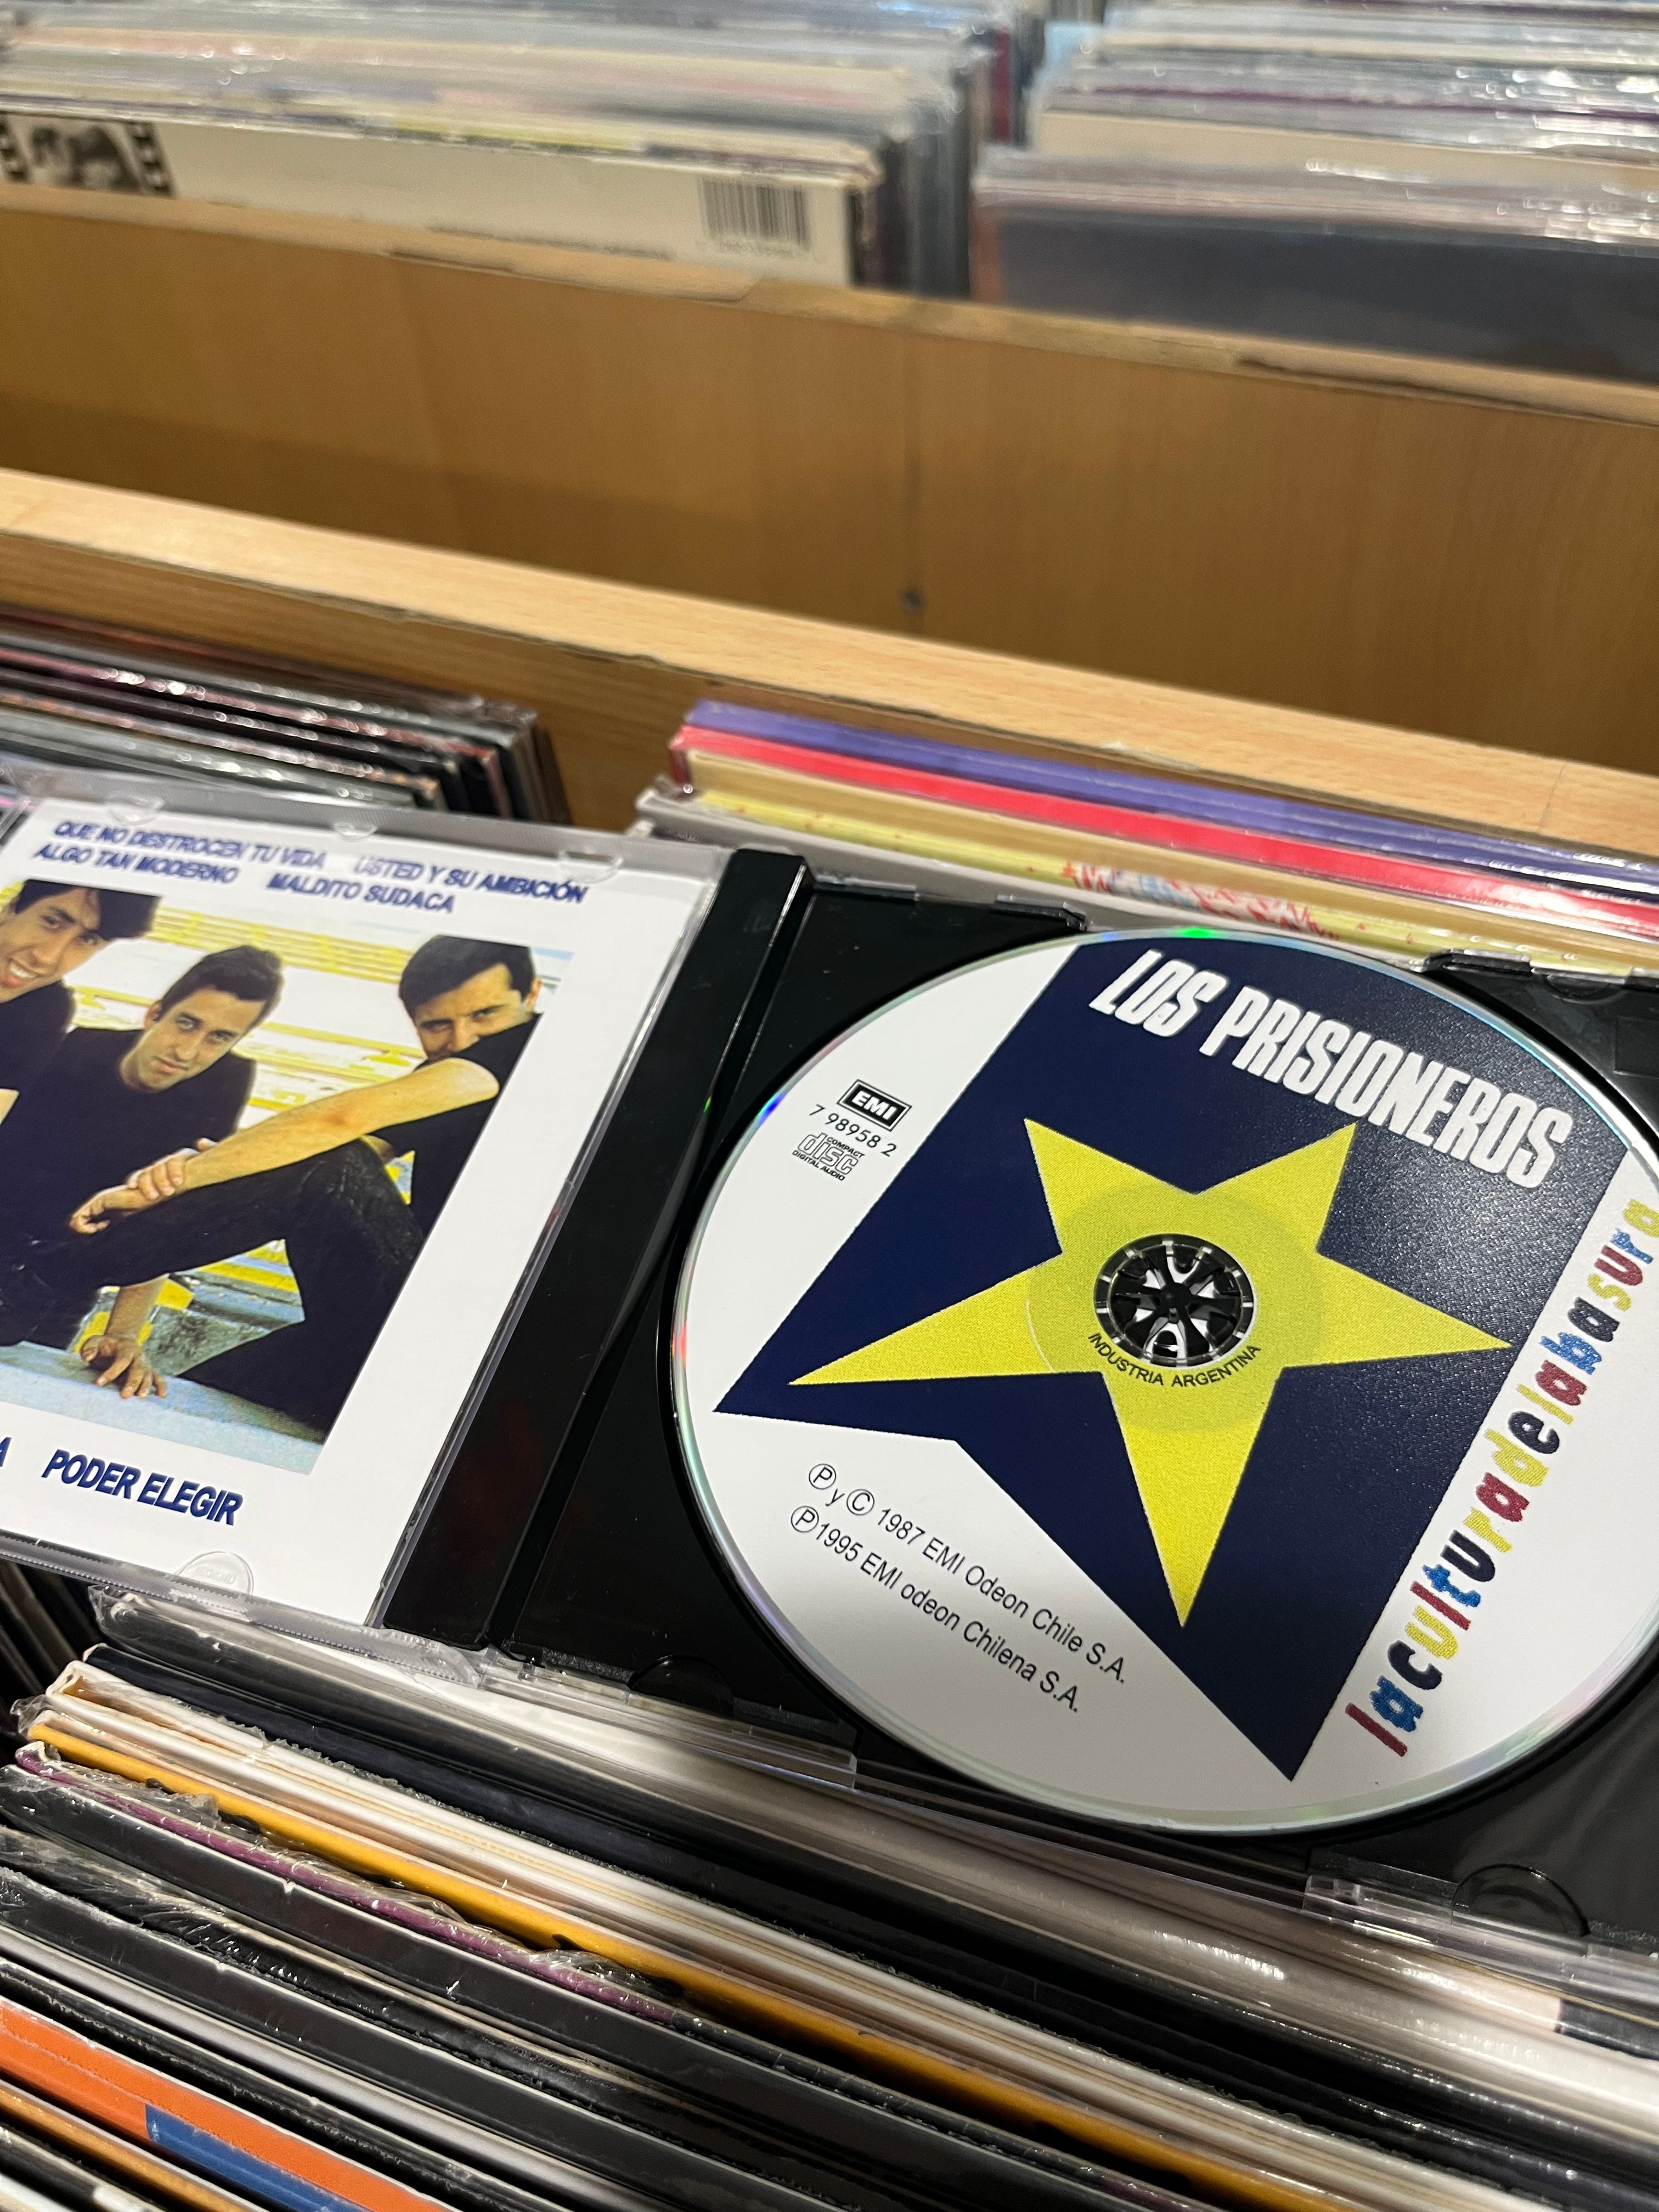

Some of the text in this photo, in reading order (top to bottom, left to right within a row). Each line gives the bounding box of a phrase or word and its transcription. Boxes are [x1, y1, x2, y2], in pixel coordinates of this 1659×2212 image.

[34, 844, 242, 884] ALGO TAN MODERNO
[55, 821, 328, 870] QUE NO DESTROCEN TU VIDA
[267, 872, 457, 913] MALDITO SUDACA
[354, 855, 589, 904] USTED Y SU AMBICIÓN
[1088, 948, 1573, 1188] LOS PRISIONEROS
[851, 1089, 898, 1120] EMI
[809, 1103, 898, 1158] 7 98958 2
[826, 1136, 866, 1159] COMPACT
[792, 1149, 845, 1181] DIGITAL AUDIO
[1087, 1332, 1262, 1387] INDUSTRIA ARGENTINA
[41, 1448, 142, 1500] PODER
[137, 1471, 244, 1526] ELEGIR
[877, 1507, 926, 1546] 1987
[922, 1536, 967, 1575] EMI
[964, 1565, 1030, 1619] Odeon
[1031, 1608, 1084, 1652] Chile
[1085, 1641, 1127, 1685] S.A.
[859, 1551, 905, 1590] EMI
[900, 1581, 961, 1632] odeon
[962, 1620, 1037, 1683] Chilena
[1039, 1670, 1079, 1713] S.A.
